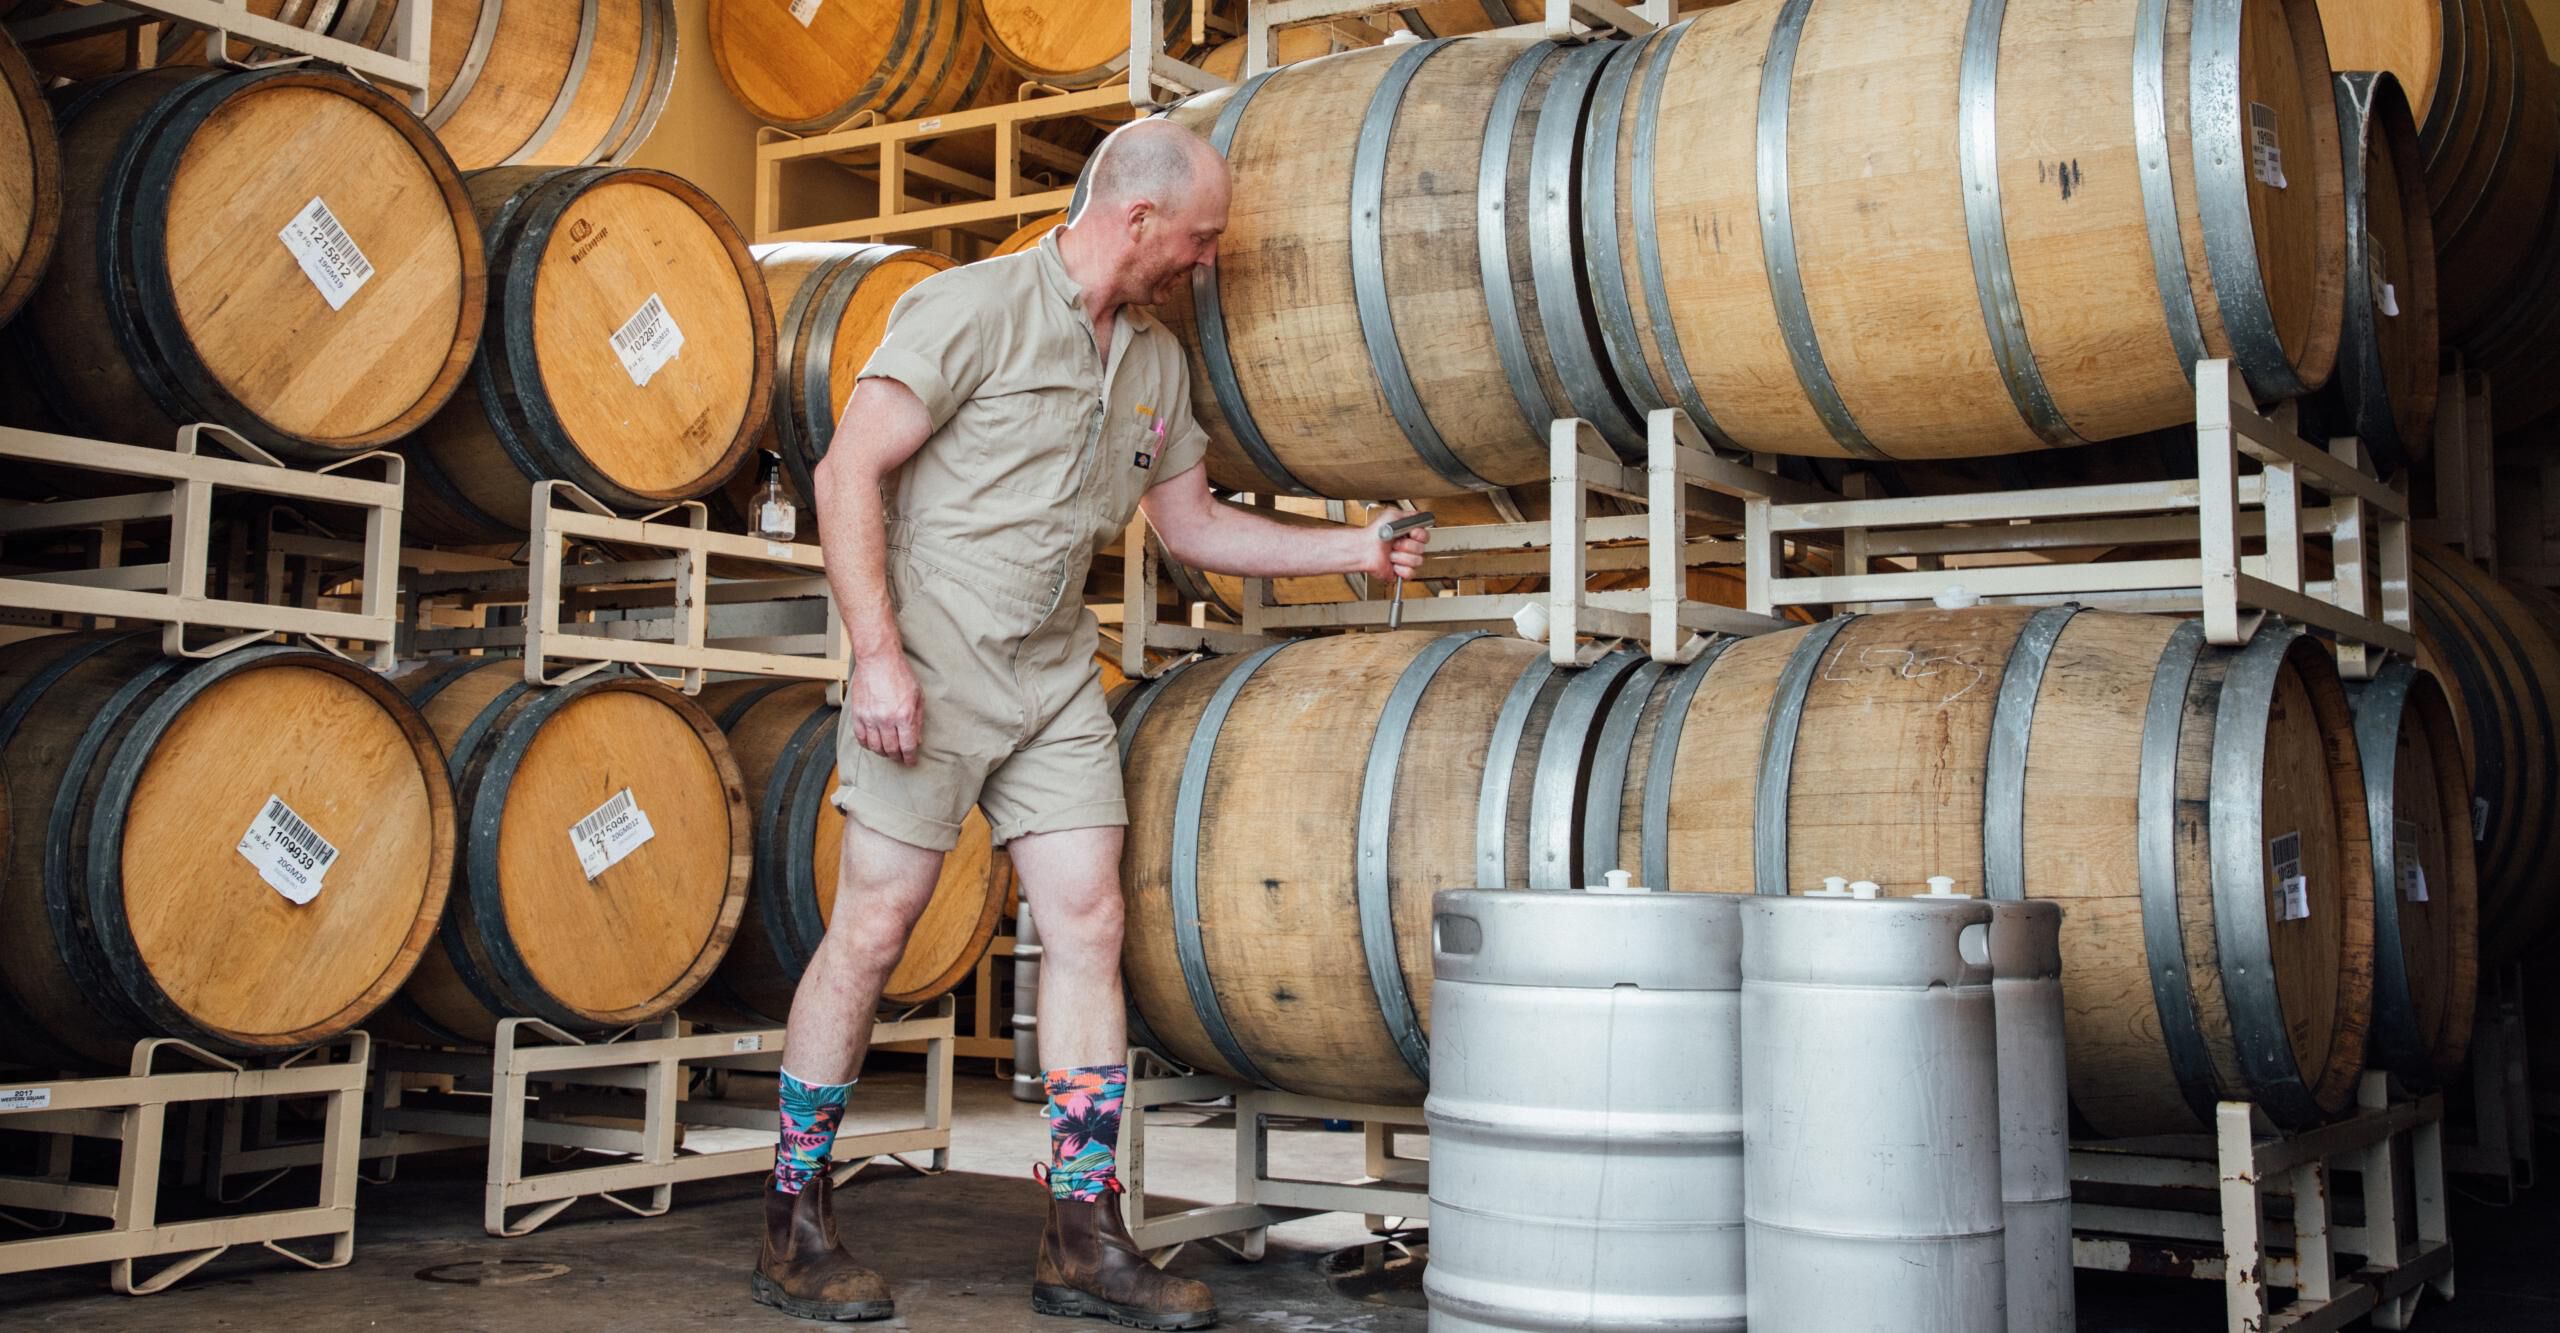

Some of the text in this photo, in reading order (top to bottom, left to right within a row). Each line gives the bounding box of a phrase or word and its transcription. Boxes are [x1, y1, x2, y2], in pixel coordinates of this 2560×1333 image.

[309, 226, 352, 279] 1215812
[318, 256, 344, 289] 19GM19
[629, 318, 664, 354] 1022977
[268, 825, 315, 870] 1109939
[277, 856, 307, 884] 20GM20
